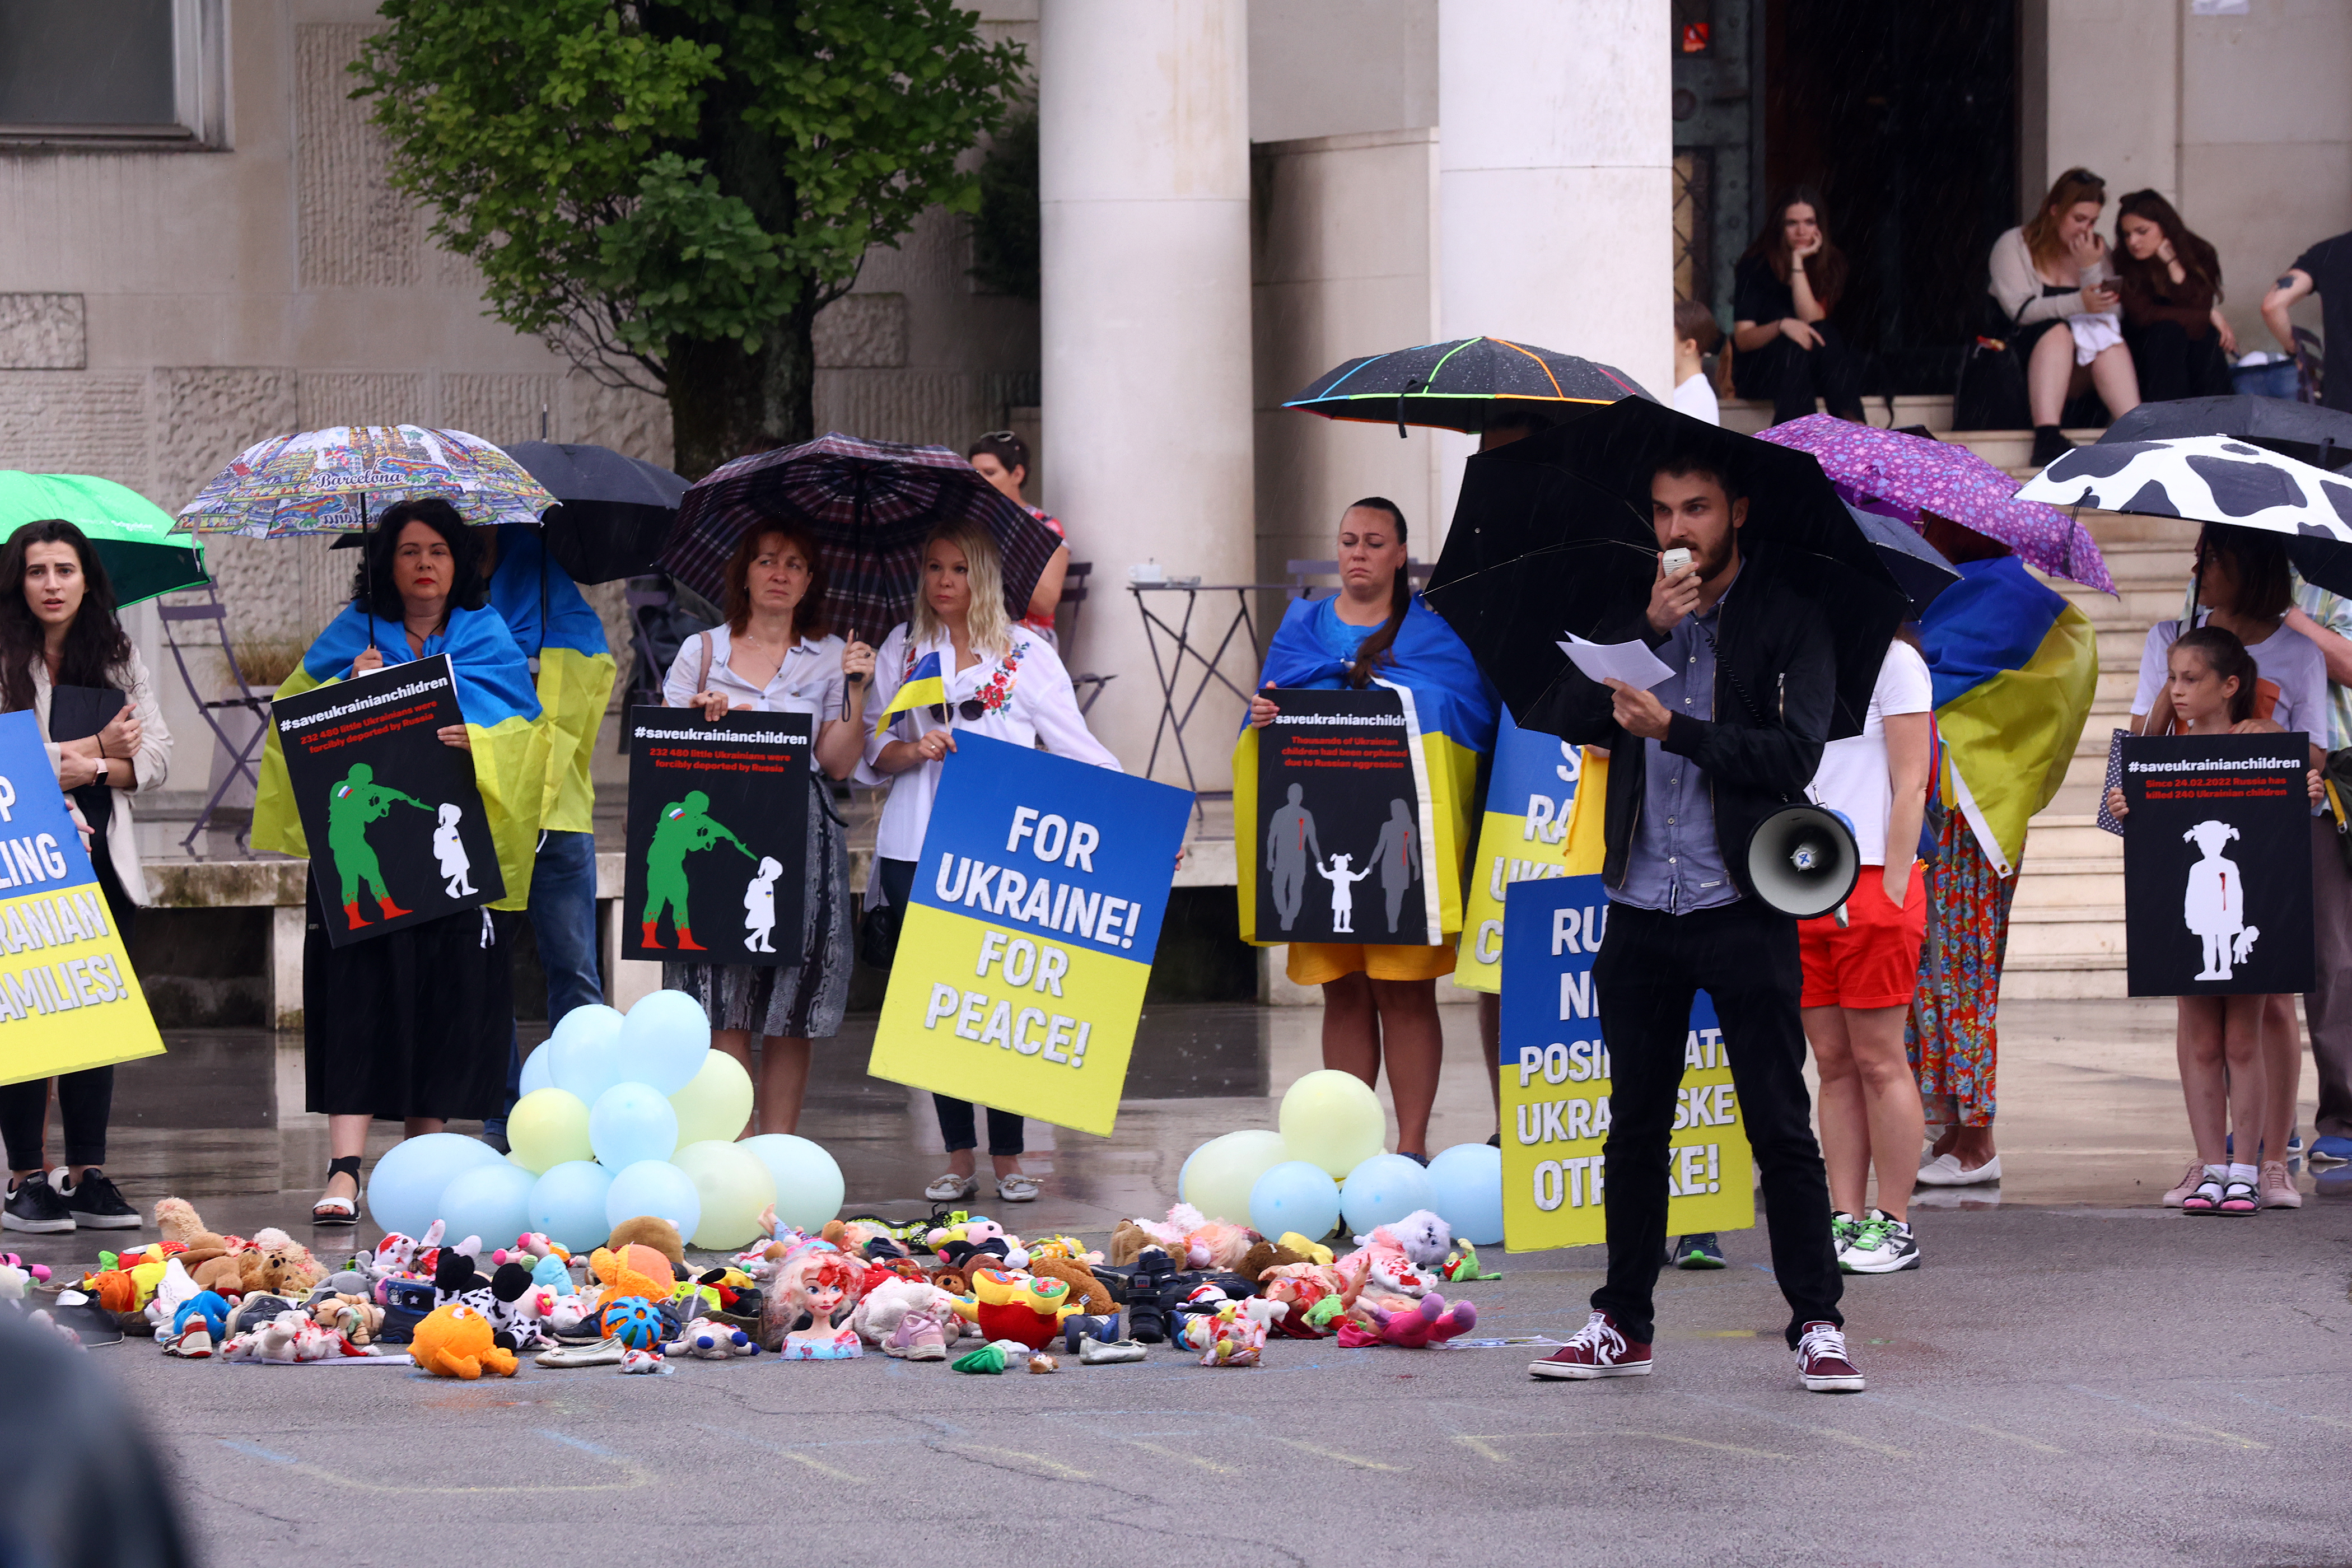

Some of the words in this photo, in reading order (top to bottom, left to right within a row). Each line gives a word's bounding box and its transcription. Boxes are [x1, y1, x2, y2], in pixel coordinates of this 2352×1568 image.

[316, 470, 404, 488] Barcelona
[280, 677, 449, 732] #saveukrainianchildren
[300, 733, 319, 745] 232
[363, 707, 413, 726] Ukrainians
[309, 738, 346, 754] forcibly
[346, 724, 389, 743] deported
[389, 722, 402, 731] by
[402, 713, 435, 727] Russia
[634, 727, 808, 745] #saveukrainianchildren
[1342, 737, 1354, 745] of
[1354, 737, 1399, 746] Ukrainian
[649, 748, 669, 757] 232
[690, 749, 713, 758] little
[714, 750, 766, 760] Ukrainians
[1320, 748, 1338, 756] had
[655, 759, 693, 771] forcibly
[693, 761, 738, 771] deported
[739, 762, 750, 773] by
[752, 763, 785, 772] Russia
[1284, 758, 1303, 767] due
[1303, 759, 1314, 767] to
[2128, 757, 2301, 773] #saveukrainianchildren
[2174, 777, 2232, 787] 24.02.2022
[2233, 777, 2267, 786] Russia
[2268, 776, 2287, 785] has
[2145, 790, 2173, 799] killed
[2196, 789, 2244, 798] Ukrainian
[2246, 788, 2288, 797] children
[1006, 805, 1100, 873] FOR
[935, 852, 1142, 950] UKRAINE!
[976, 930, 1069, 997] FOR
[923, 982, 1092, 1068] PEACE!
